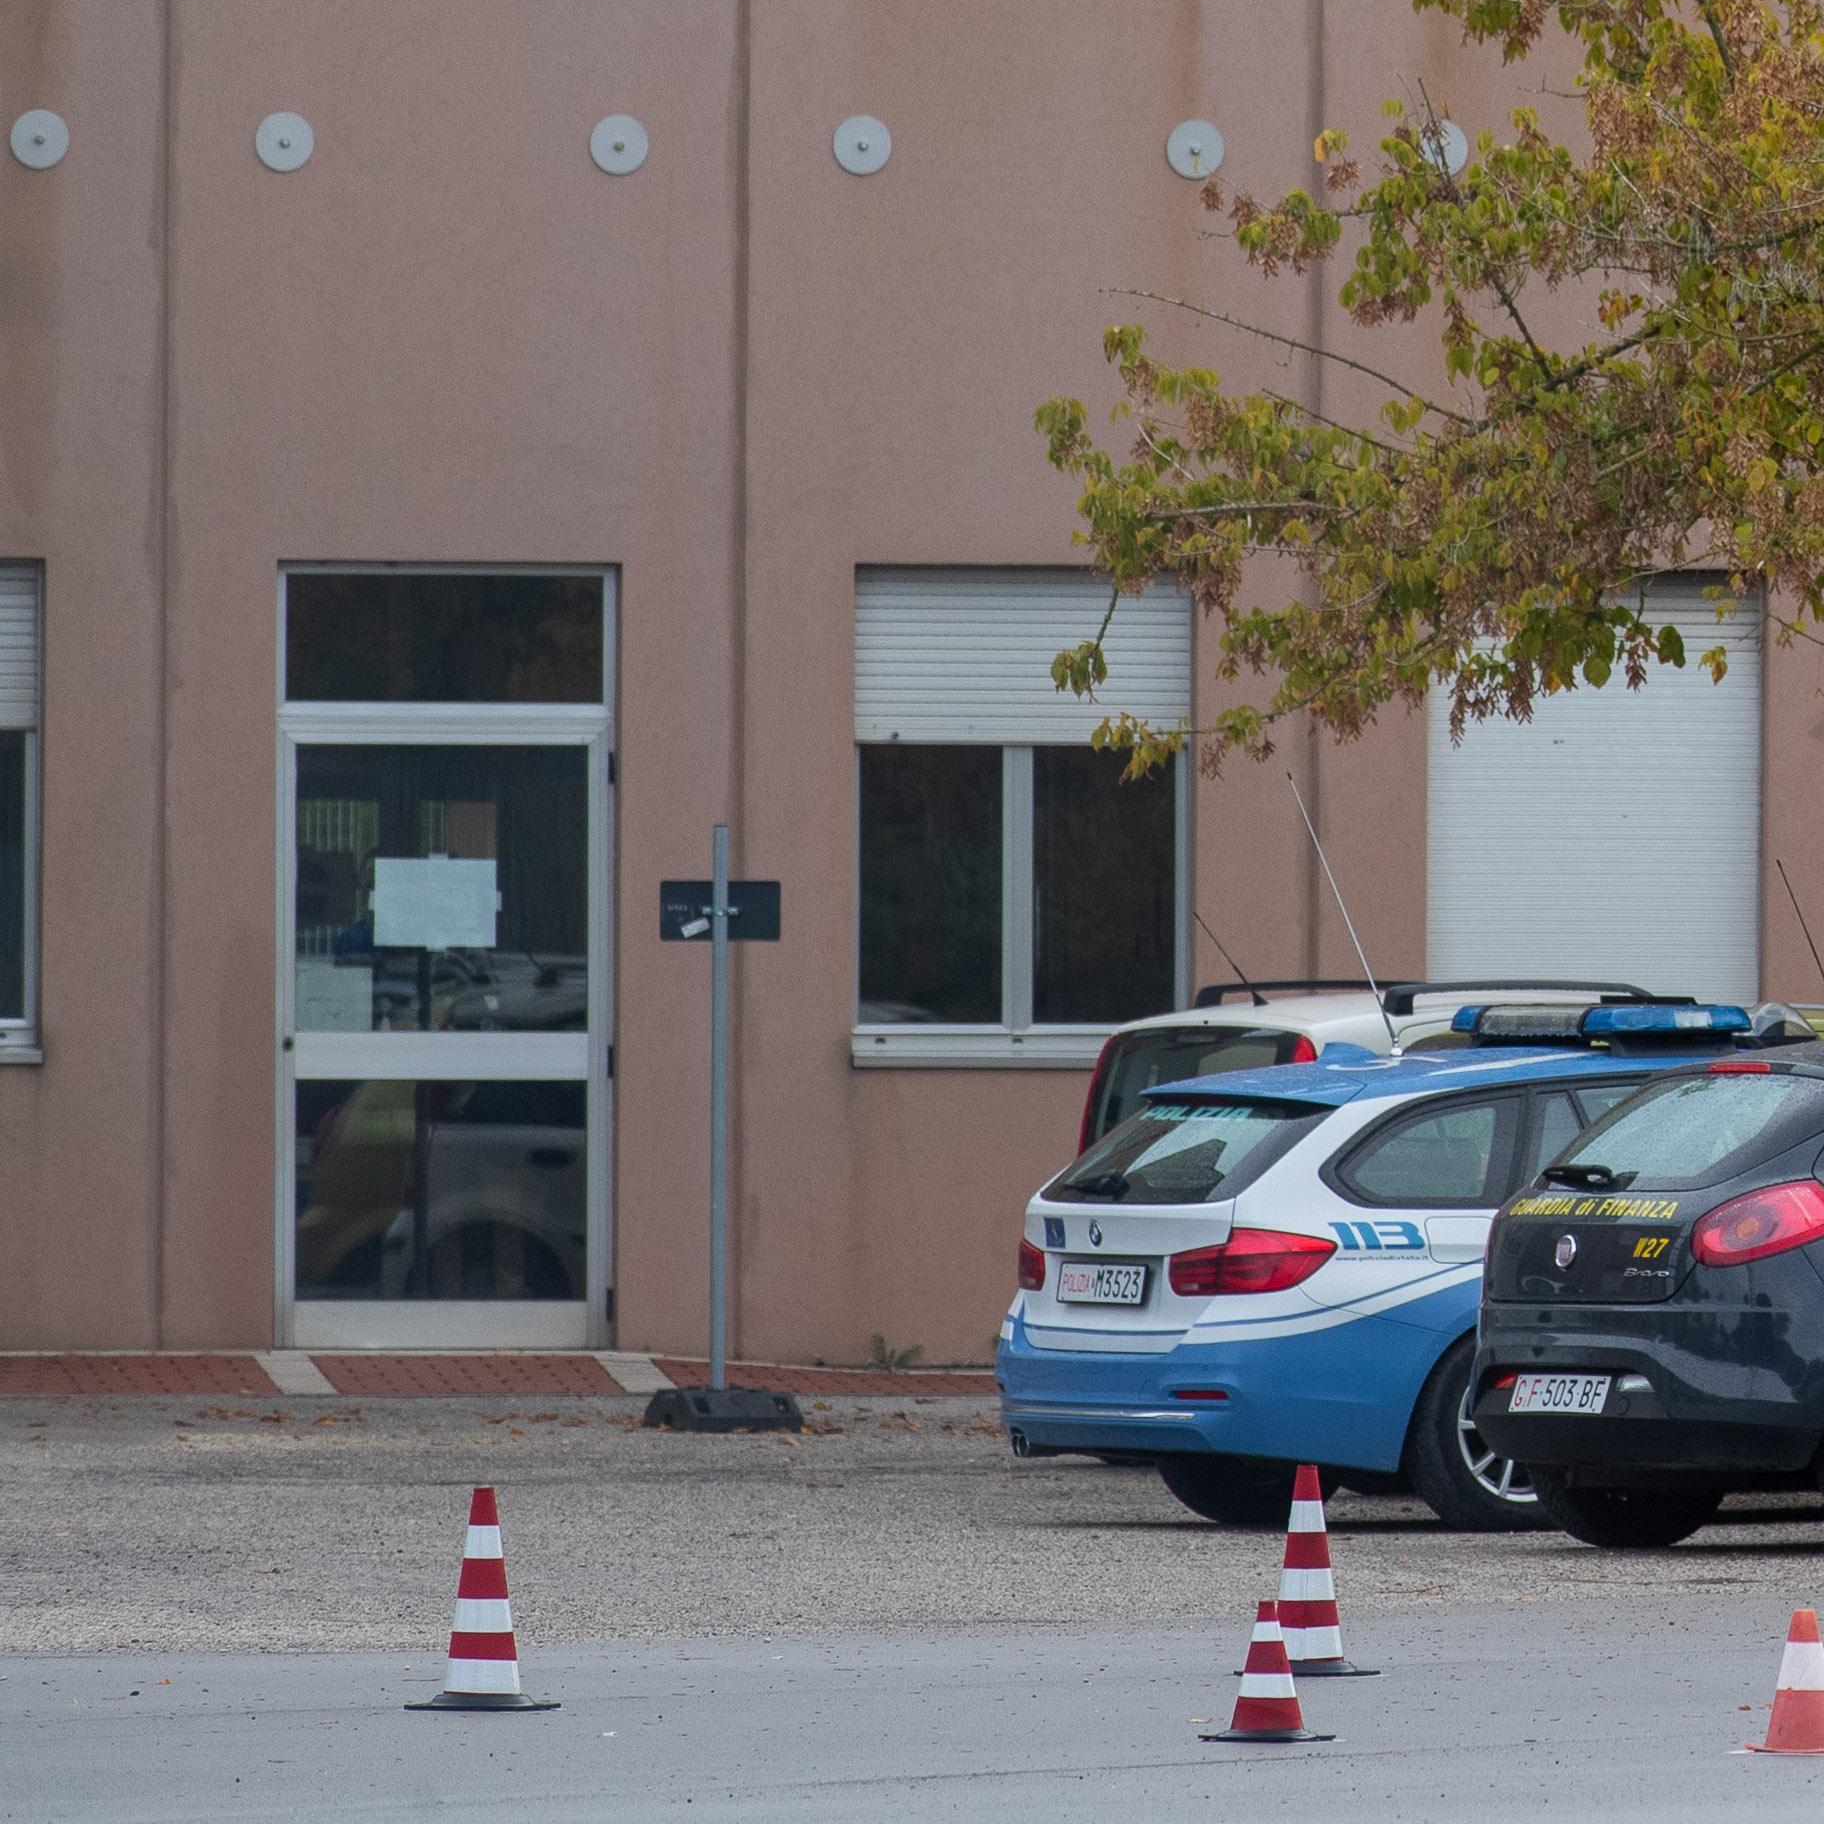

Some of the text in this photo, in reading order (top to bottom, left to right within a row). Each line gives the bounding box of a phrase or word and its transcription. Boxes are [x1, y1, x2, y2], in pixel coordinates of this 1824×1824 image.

[1509, 1198, 1678, 1219] GUARDIA di FINANZA
[1327, 1221, 1425, 1251] 113
